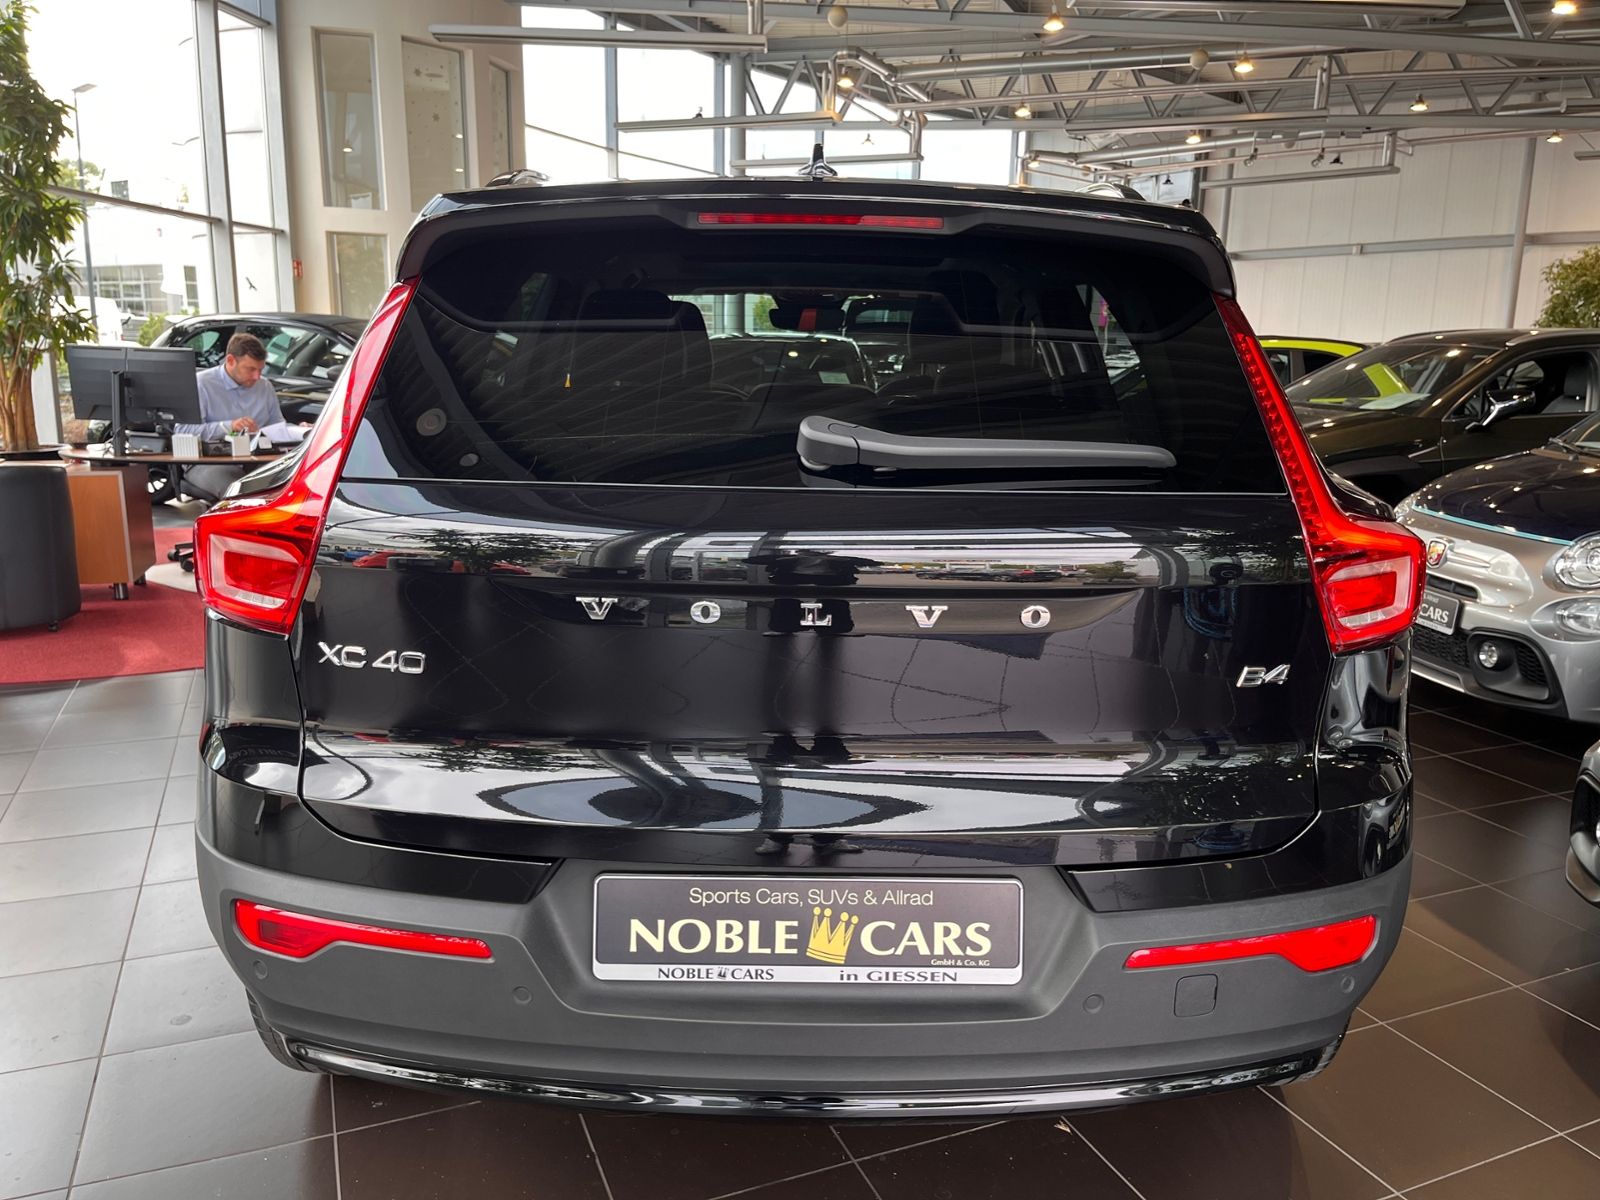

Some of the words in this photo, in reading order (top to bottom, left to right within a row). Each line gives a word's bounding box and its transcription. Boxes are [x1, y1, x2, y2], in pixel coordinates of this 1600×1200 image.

[576, 597, 1051, 629] VOLVO
[318, 641, 366, 668] XC
[372, 650, 426, 674] 40
[1236, 664, 1291, 687] B4
[689, 887, 751, 907] Sports
[755, 888, 803, 907] Cars,
[808, 889, 858, 906] SUVs
[863, 890, 877, 905] &
[882, 890, 934, 906] Allrad
[629, 918, 799, 955] NOBLE
[860, 920, 992, 957] CARS
[657, 967, 714, 980] NOBLE
[731, 968, 775, 980] CARS
[839, 970, 859, 982] in
[866, 971, 957, 983] GIESSEN
